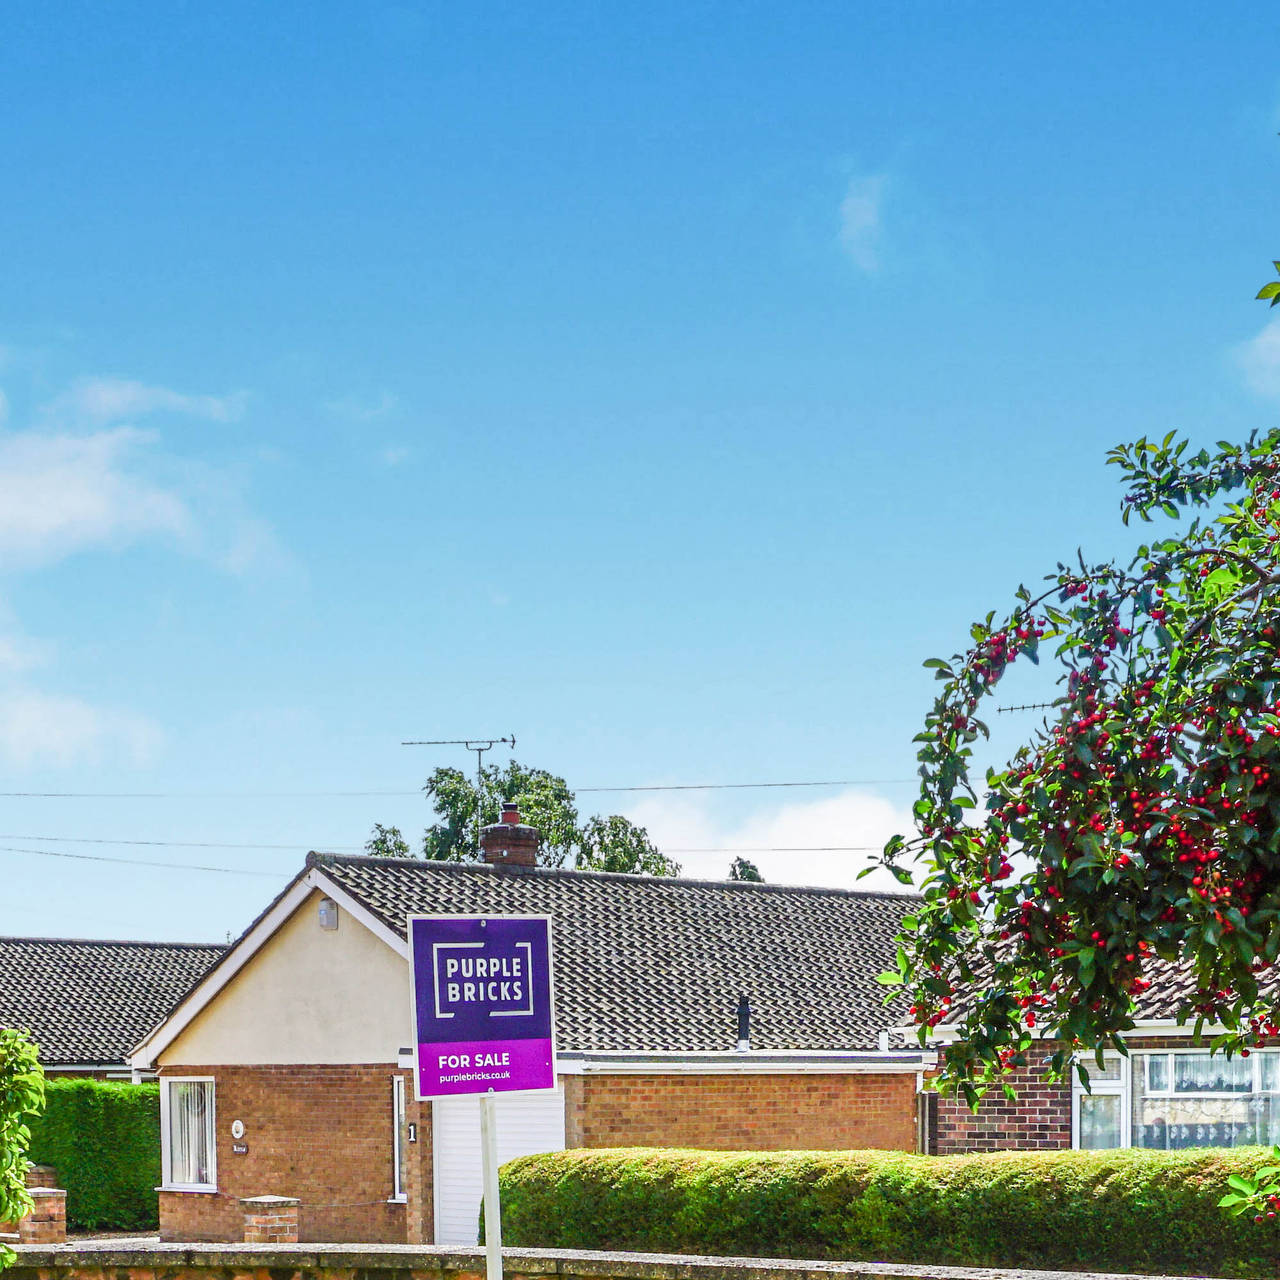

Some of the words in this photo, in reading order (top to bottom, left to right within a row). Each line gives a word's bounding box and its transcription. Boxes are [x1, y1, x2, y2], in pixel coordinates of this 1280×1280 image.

[446, 957, 522, 978] PURPLE
[447, 981, 523, 1002] BRICKS
[438, 1054, 470, 1069] FOR
[474, 1052, 510, 1067] SALE
[439, 1070, 511, 1084] purplebricks.co.uk
[408, 1125, 416, 1142] 1
